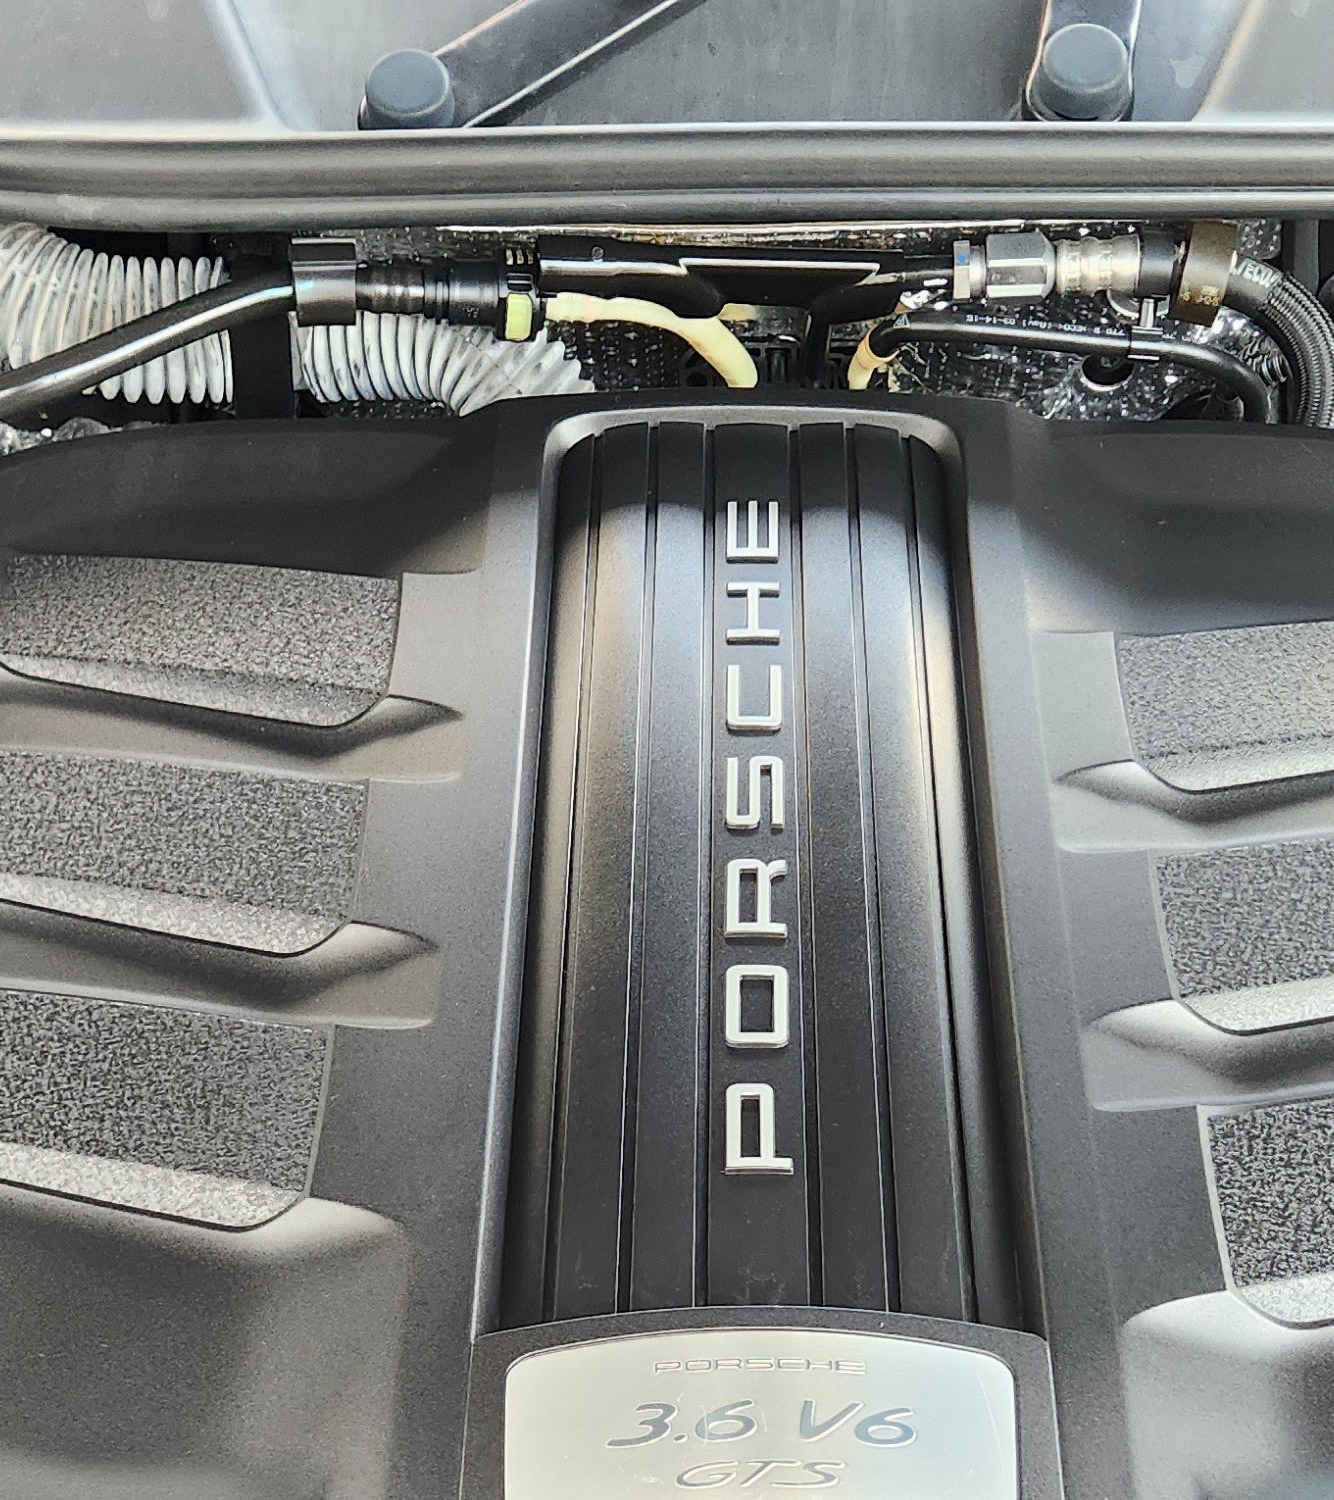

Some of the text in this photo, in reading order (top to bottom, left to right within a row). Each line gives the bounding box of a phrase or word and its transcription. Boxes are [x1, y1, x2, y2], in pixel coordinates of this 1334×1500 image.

[725, 500, 794, 1177] PORSCHE
[653, 1355, 867, 1375] PORSCHE
[605, 1397, 918, 1449] 3.6 V6
[674, 1460, 846, 1489] GTS
